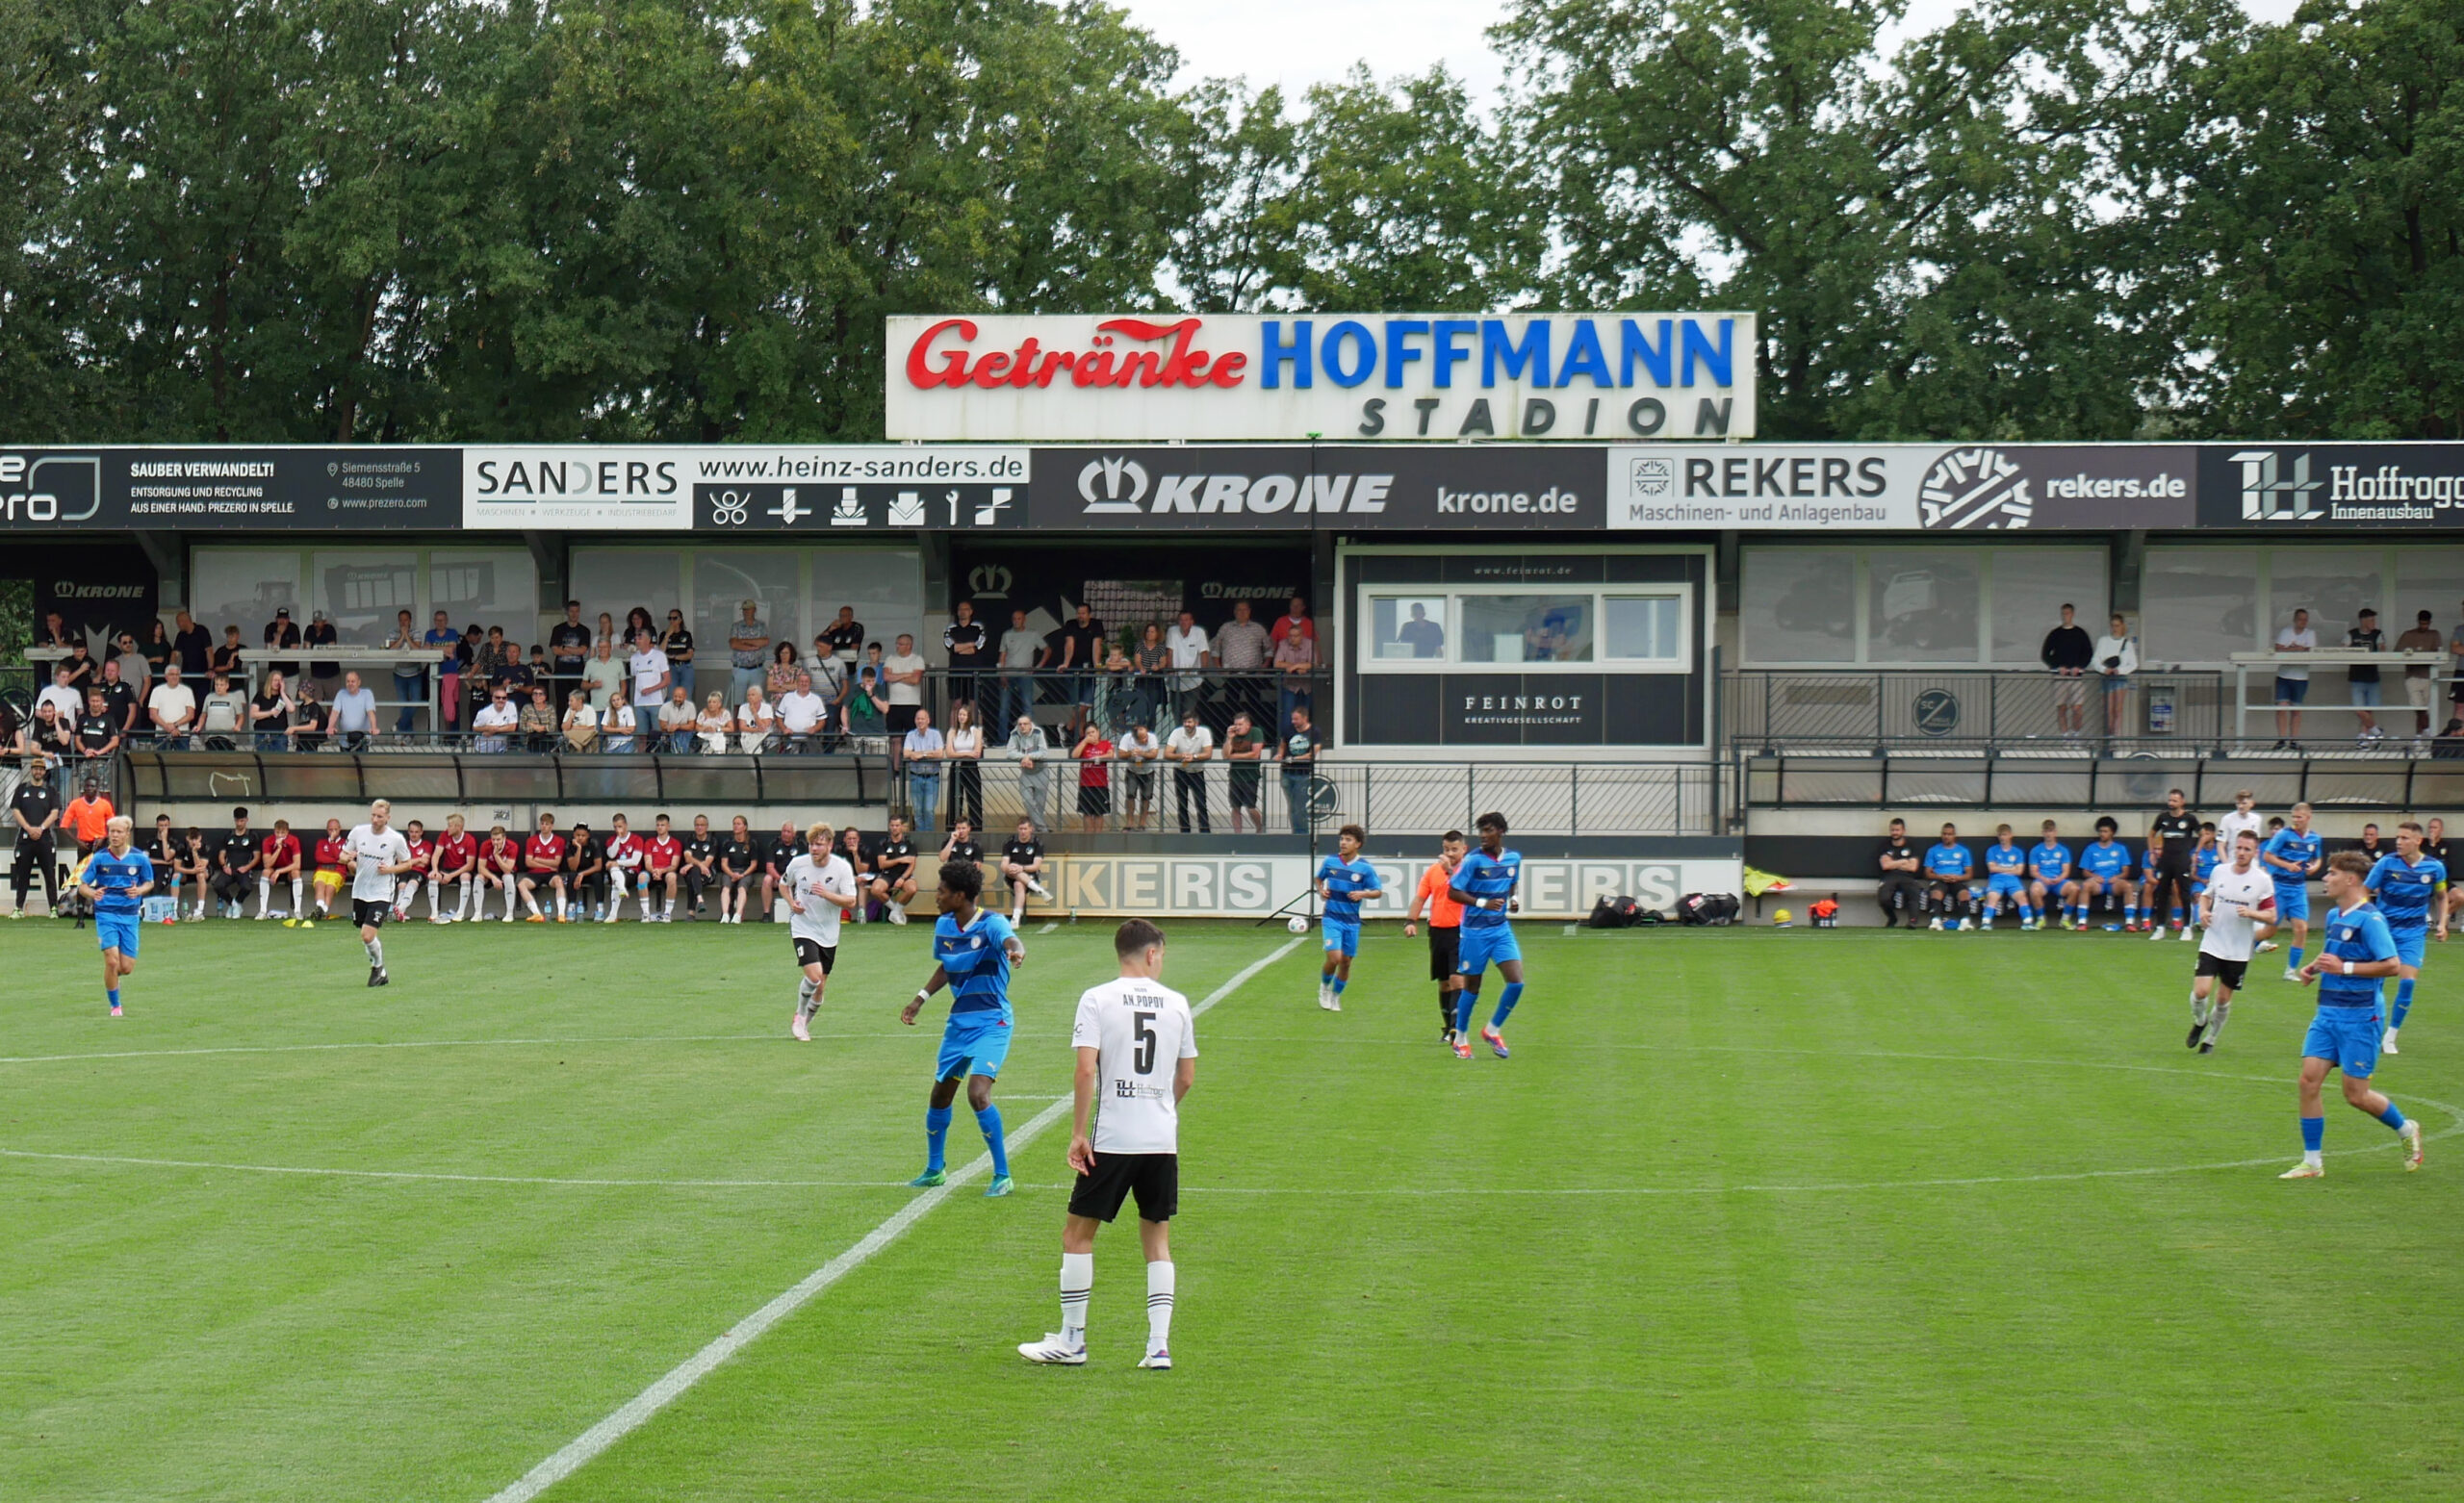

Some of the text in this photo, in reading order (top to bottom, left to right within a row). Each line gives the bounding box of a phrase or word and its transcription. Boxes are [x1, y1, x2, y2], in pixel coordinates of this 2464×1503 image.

[907, 318, 1733, 390] Getränke HOFFMANN
[1358, 396, 1733, 437] STADION
[130, 463, 275, 477] SAUBER VERWANDELT!
[342, 462, 421, 473] Siemensstraße 5
[699, 455, 1023, 478] www.heinz-sanders.de
[342, 477, 404, 490] 48480 Spelle
[476, 461, 678, 495] SANDERS
[1684, 457, 1887, 498] REKERS
[2046, 473, 2187, 498] rekers.de
[130, 486, 264, 497] ENTSORGUNG UND RECYCLING
[1151, 474, 1395, 514] KRONE
[1436, 486, 1578, 515] krone.de
[130, 502, 295, 513] AUS EINER HAND: PREZERO IN SPELLE.
[342, 498, 427, 510] www.prezero.com
[476, 508, 678, 517] MASCHINEN WERKZEUGE INDUSTRIEBEDARF
[2330, 502, 2434, 520] Innenausbau
[1630, 504, 1886, 524] Maschinen- und Anlagenbau
[76, 585, 144, 598] KRONE
[1223, 587, 1296, 599] KRONE
[1465, 697, 1581, 710] FEINROT
[1134, 1011, 1156, 1075] 5
